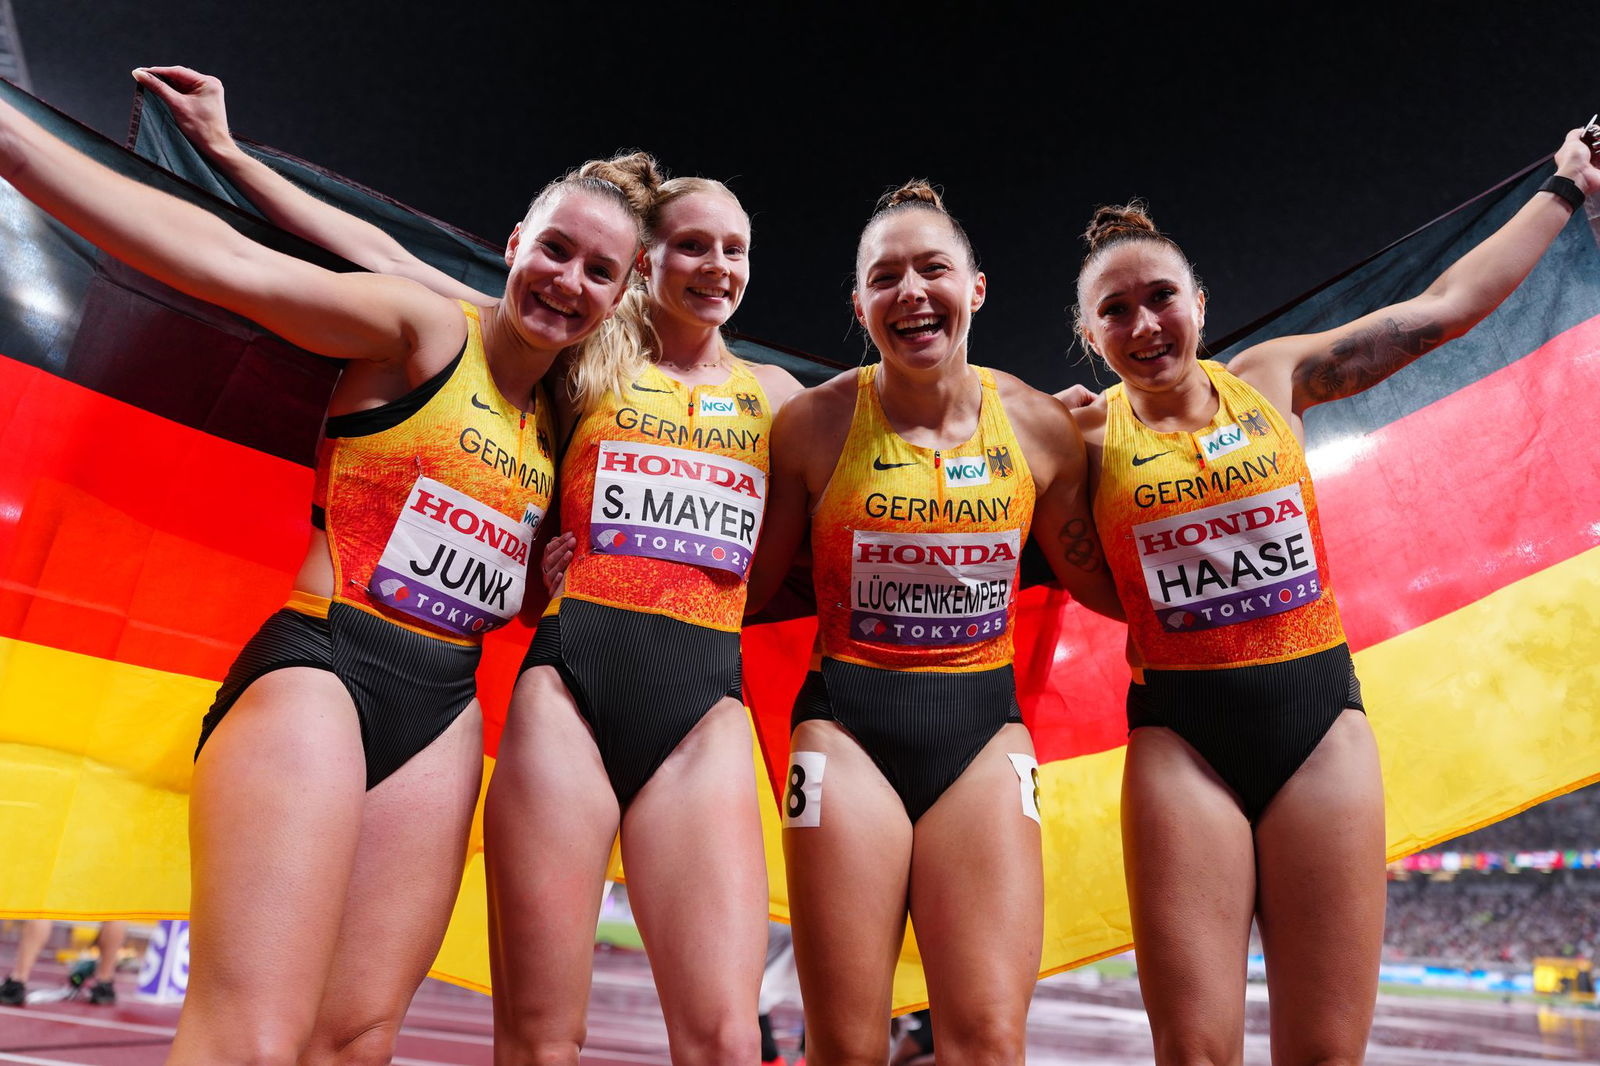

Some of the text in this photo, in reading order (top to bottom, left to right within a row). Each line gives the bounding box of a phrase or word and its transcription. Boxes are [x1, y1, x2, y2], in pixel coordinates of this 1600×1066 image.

[616, 407, 760, 453] GERMANY
[702, 400, 734, 412] WGV
[460, 428, 555, 498] GERMAN
[1204, 428, 1242, 454] WGV
[601, 451, 762, 500] HONDA
[946, 462, 986, 480] WGV
[1134, 451, 1280, 508] GERMANY
[410, 489, 528, 566] HONDA
[602, 484, 756, 545] S. MAYER
[865, 493, 1011, 523] GERMANY
[1139, 498, 1303, 556] HONDA
[410, 544, 513, 611] JUNK
[857, 542, 1016, 566] HONDA
[1157, 533, 1309, 603] HAASE
[857, 574, 1008, 615] LÜCKENKEMPER
[787, 763, 807, 819] 8
